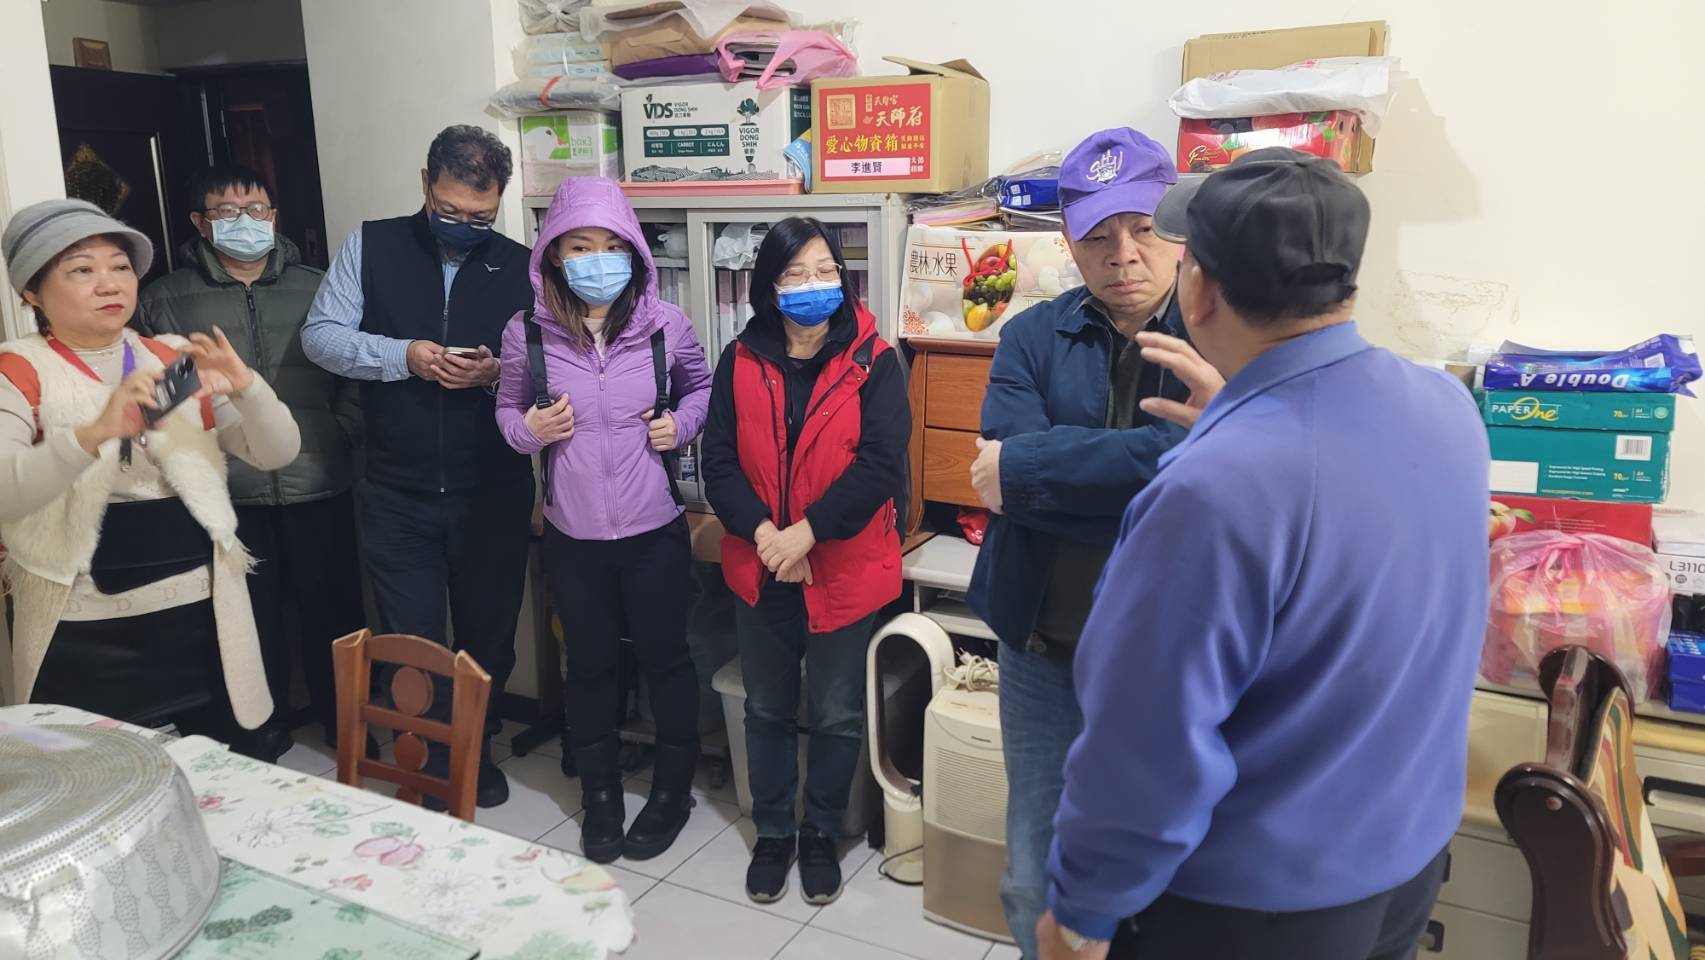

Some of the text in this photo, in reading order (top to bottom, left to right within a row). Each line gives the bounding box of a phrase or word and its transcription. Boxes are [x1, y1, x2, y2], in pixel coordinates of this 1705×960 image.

[642, 102, 674, 119] VDS
[875, 106, 923, 128] 天師府
[826, 133, 898, 154] 愛心物資箱
[851, 161, 882, 173] 李進賢
[1520, 373, 1631, 388] Double A
[1669, 560, 1705, 574] L3110
